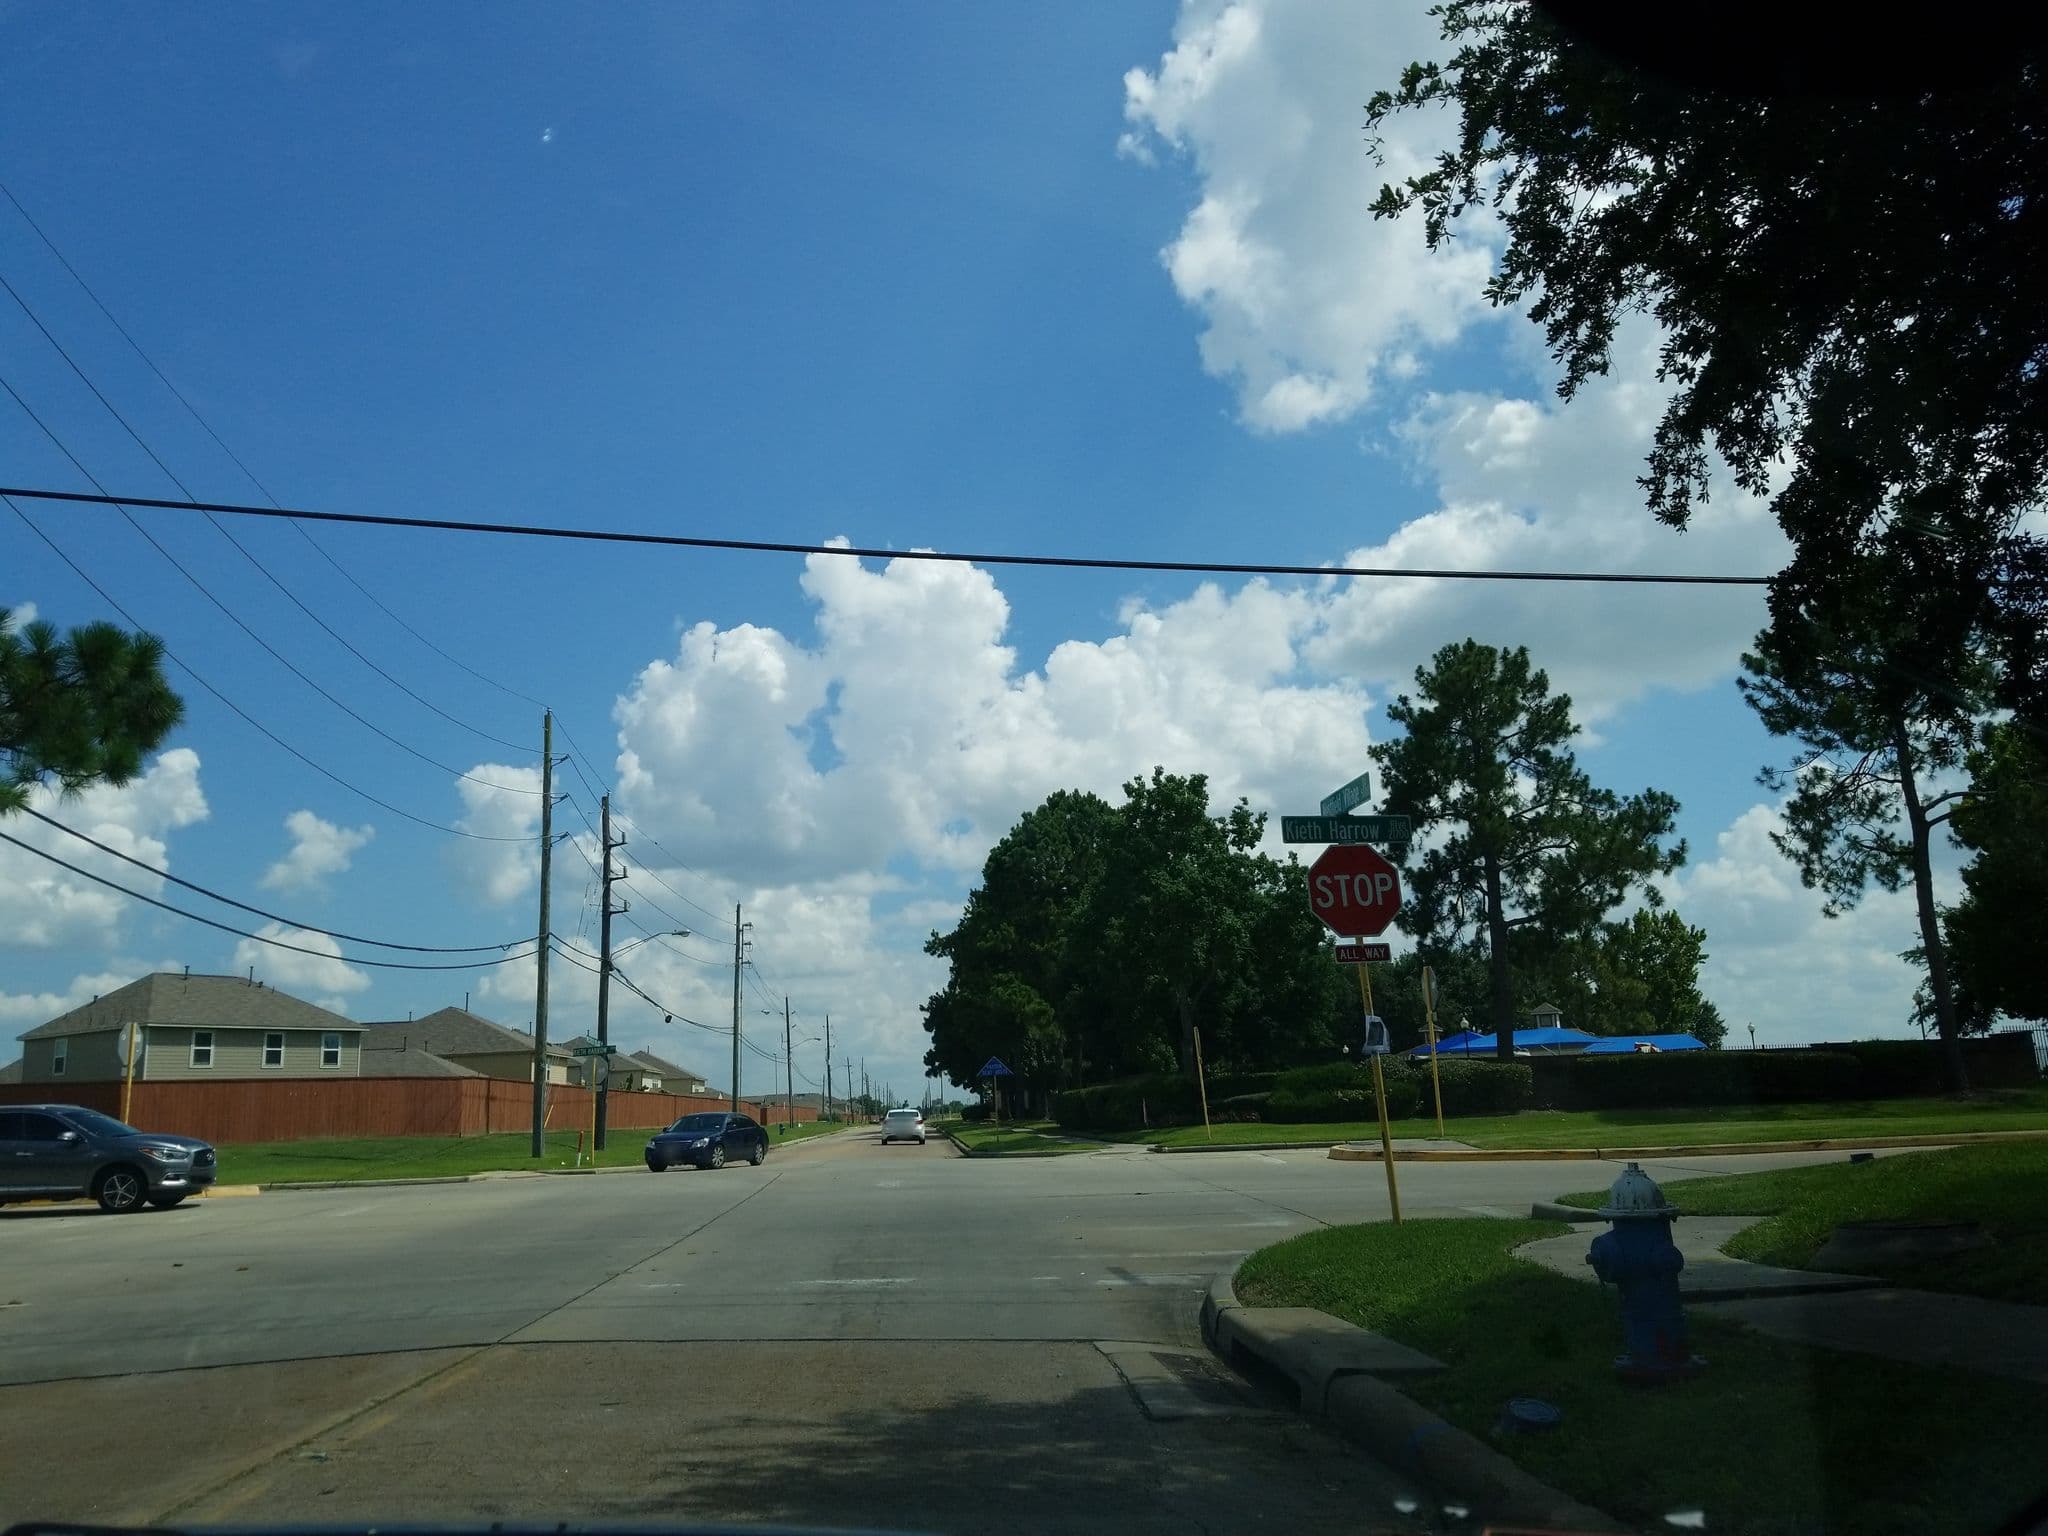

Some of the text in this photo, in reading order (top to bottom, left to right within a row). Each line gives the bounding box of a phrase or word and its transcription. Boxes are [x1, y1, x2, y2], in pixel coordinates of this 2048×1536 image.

[1285, 820, 1322, 841] Kieth
[1329, 820, 1380, 841] Harrow
[1314, 872, 1393, 908] STOP
[1339, 947, 1385, 960] ALL WAY
